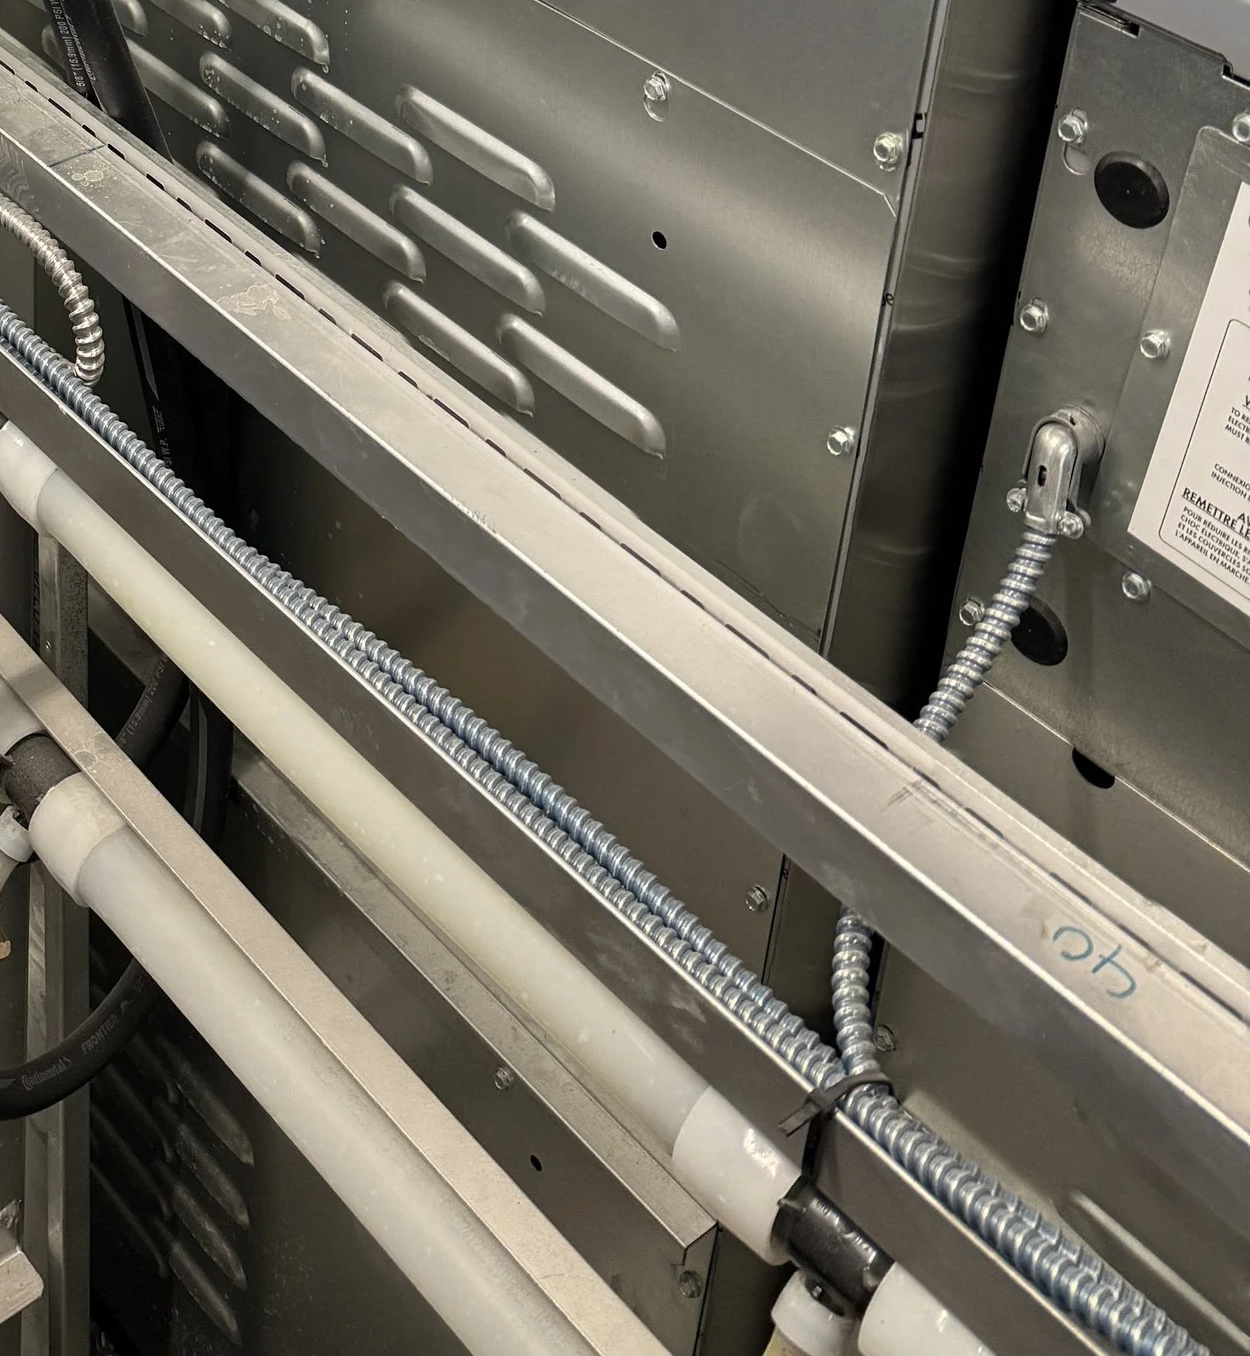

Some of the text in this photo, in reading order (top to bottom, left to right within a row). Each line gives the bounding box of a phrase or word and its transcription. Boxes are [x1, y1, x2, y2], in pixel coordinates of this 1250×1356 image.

[1225, 424, 1244, 440] MUST
[1211, 471, 1247, 499] INJECTION
[1181, 514, 1200, 531] CHOC
[1182, 487, 1238, 530] REMETTRE
[1178, 522, 1186, 530] ET
[1186, 528, 1197, 539] LES
[1198, 536, 1241, 568] COUVERCLES
[1183, 506, 1202, 522] POUR
[1231, 538, 1242, 550] LES
[1175, 529, 1208, 556] L'APPAREIL
[1210, 553, 1219, 564] EN
